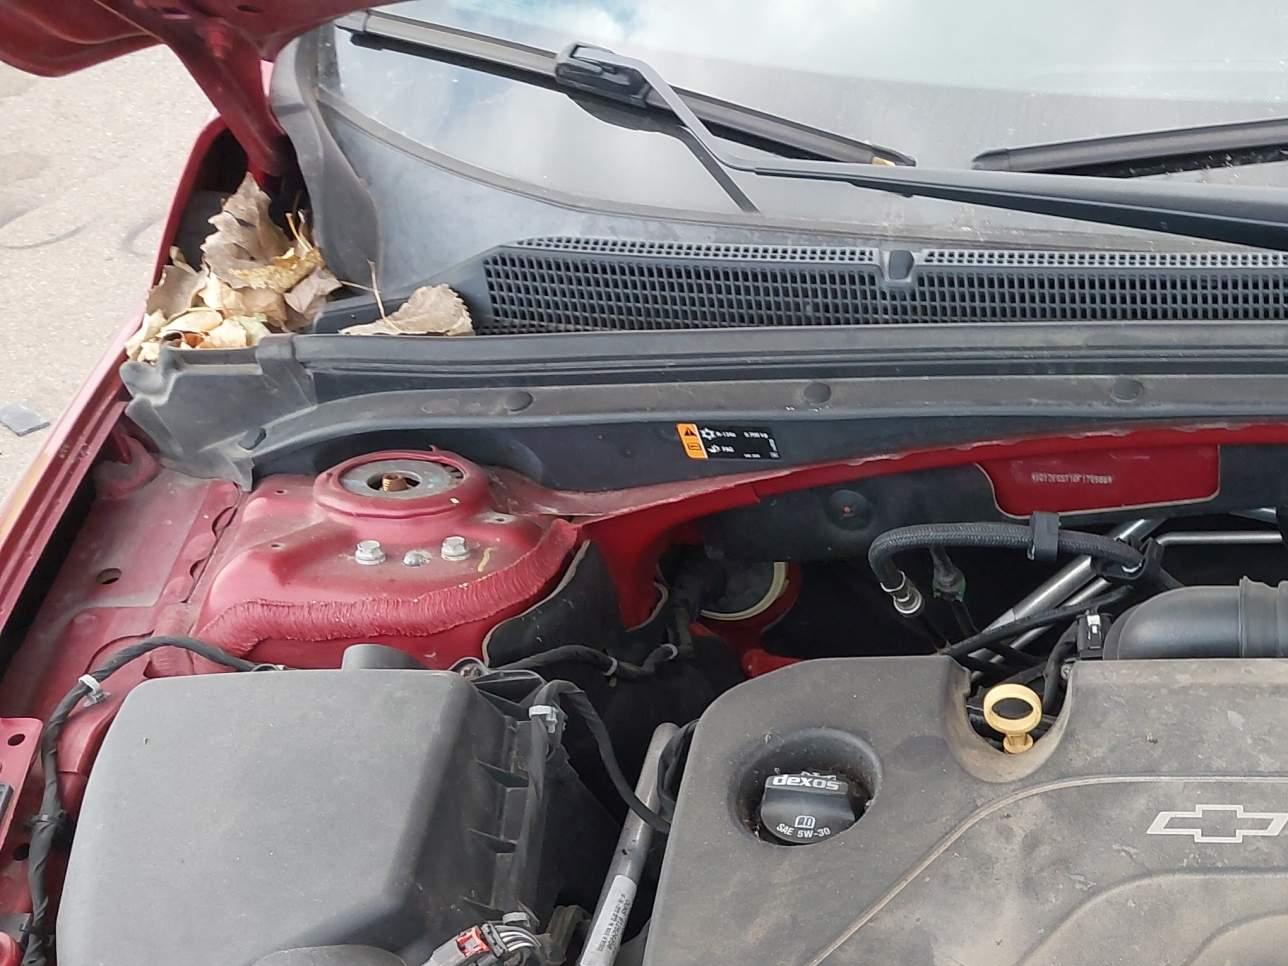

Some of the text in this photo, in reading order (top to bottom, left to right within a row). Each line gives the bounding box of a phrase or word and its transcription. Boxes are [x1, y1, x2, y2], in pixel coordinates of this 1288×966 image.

[772, 774, 840, 791] dexos
[776, 823, 831, 839] SAE 5W-30
